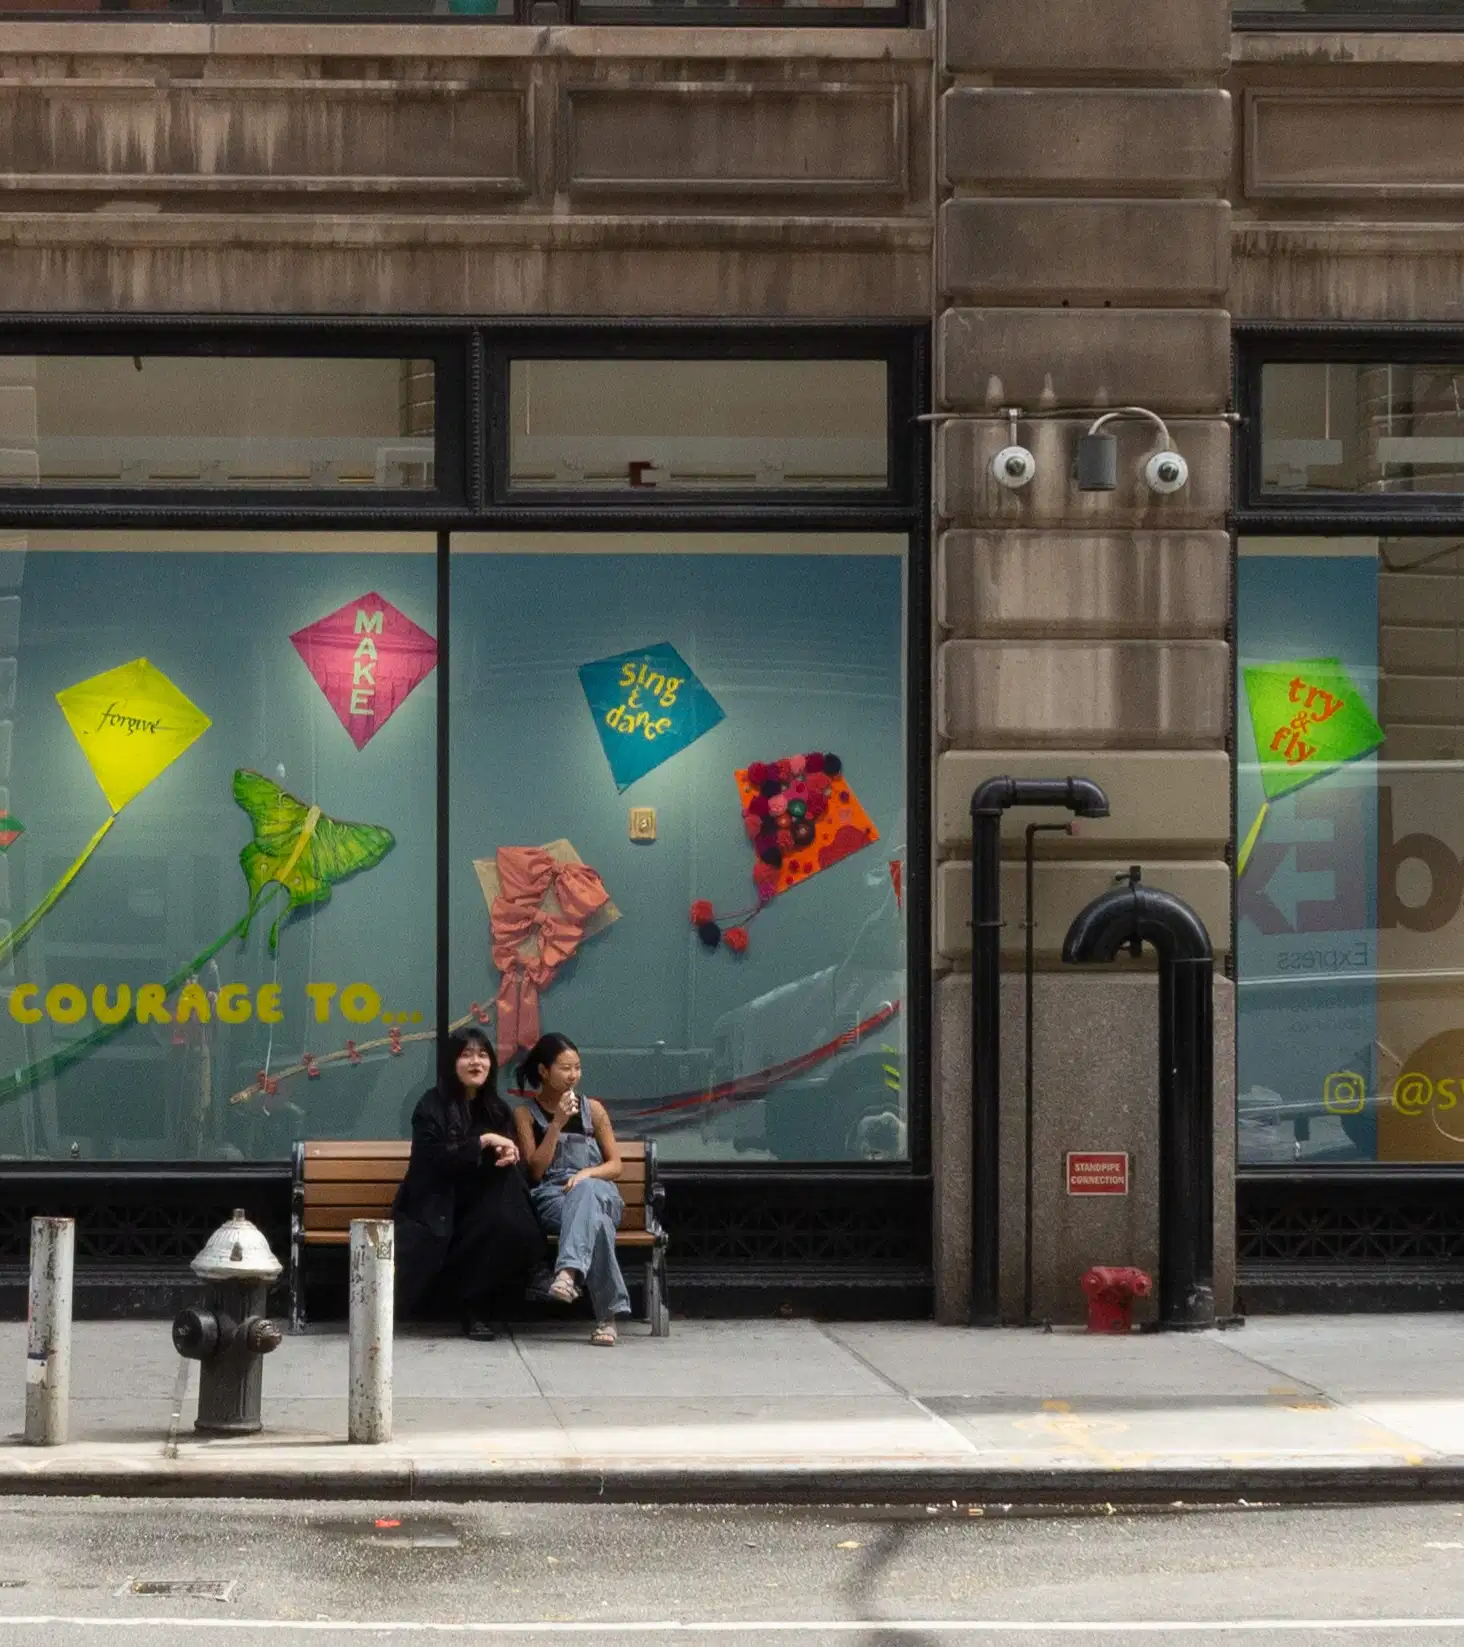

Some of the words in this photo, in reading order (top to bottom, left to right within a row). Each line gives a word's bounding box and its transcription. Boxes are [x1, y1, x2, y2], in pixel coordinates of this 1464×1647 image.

[350, 609, 384, 715] MAKE
[96, 701, 182, 736] forgive
[1288, 677, 1344, 722] try
[606, 705, 672, 740] dance
[1270, 726, 1317, 766] fly
[8, 983, 284, 1024] COURAGE
[1393, 1072, 1464, 1115] @s
[1071, 1176, 1124, 1184] CONNECTION
[1074, 1163, 1121, 1172] STANDPIPE
